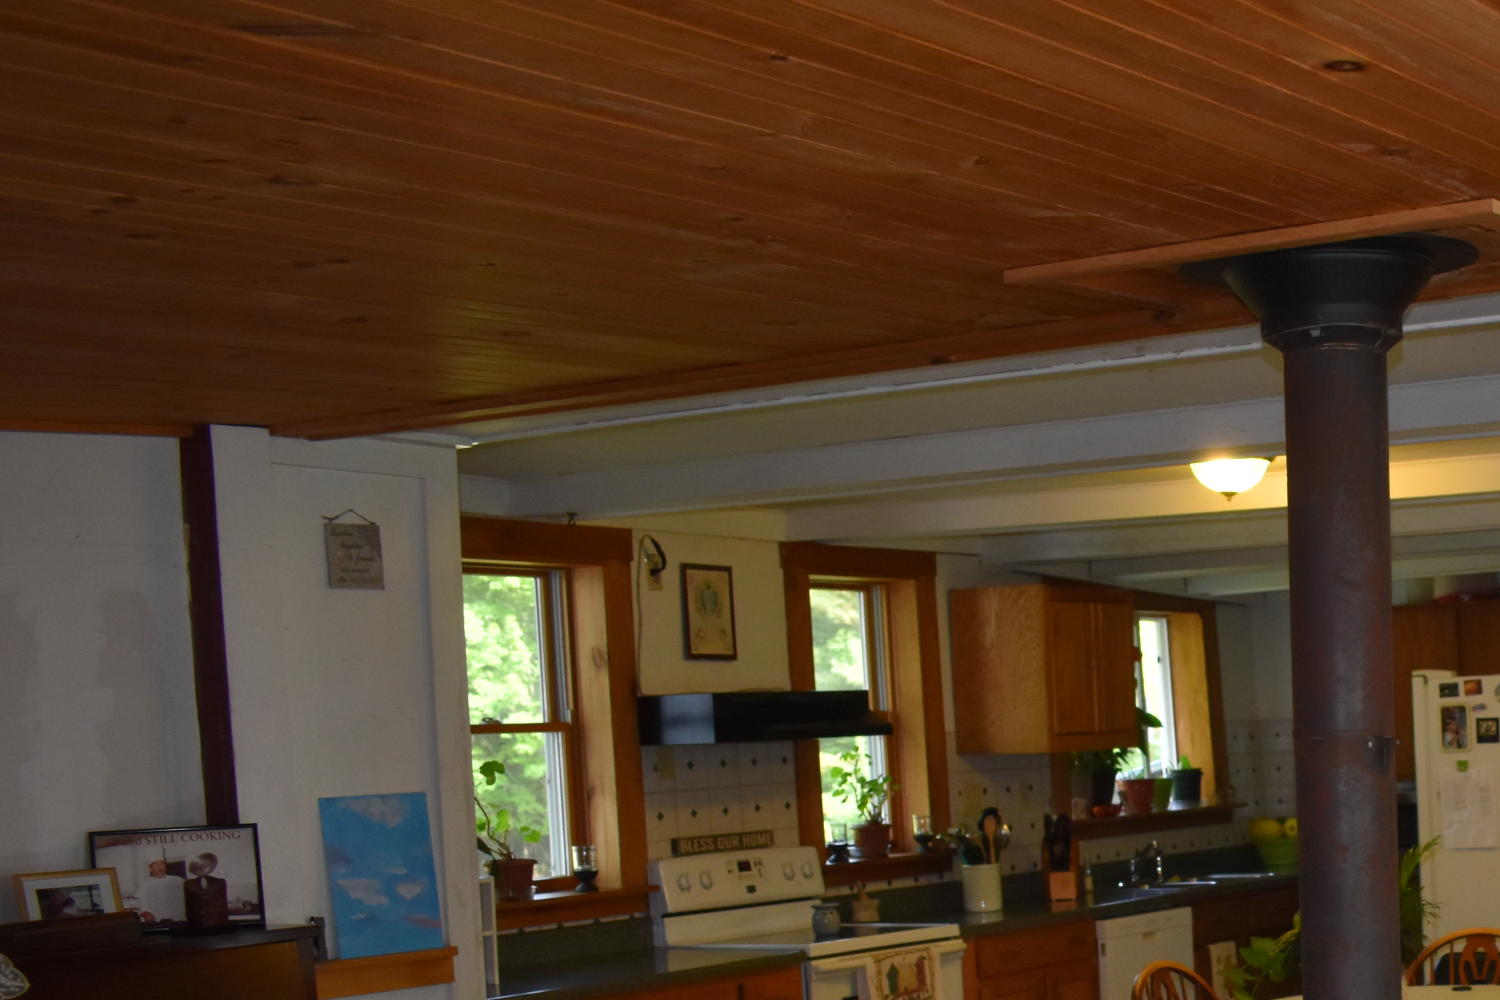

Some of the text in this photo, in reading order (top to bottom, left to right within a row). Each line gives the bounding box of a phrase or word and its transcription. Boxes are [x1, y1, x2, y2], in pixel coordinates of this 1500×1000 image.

[145, 833, 175, 845] STILL
[181, 831, 241, 843] COOKING
[680, 831, 773, 853] BLESS OUR HOME
